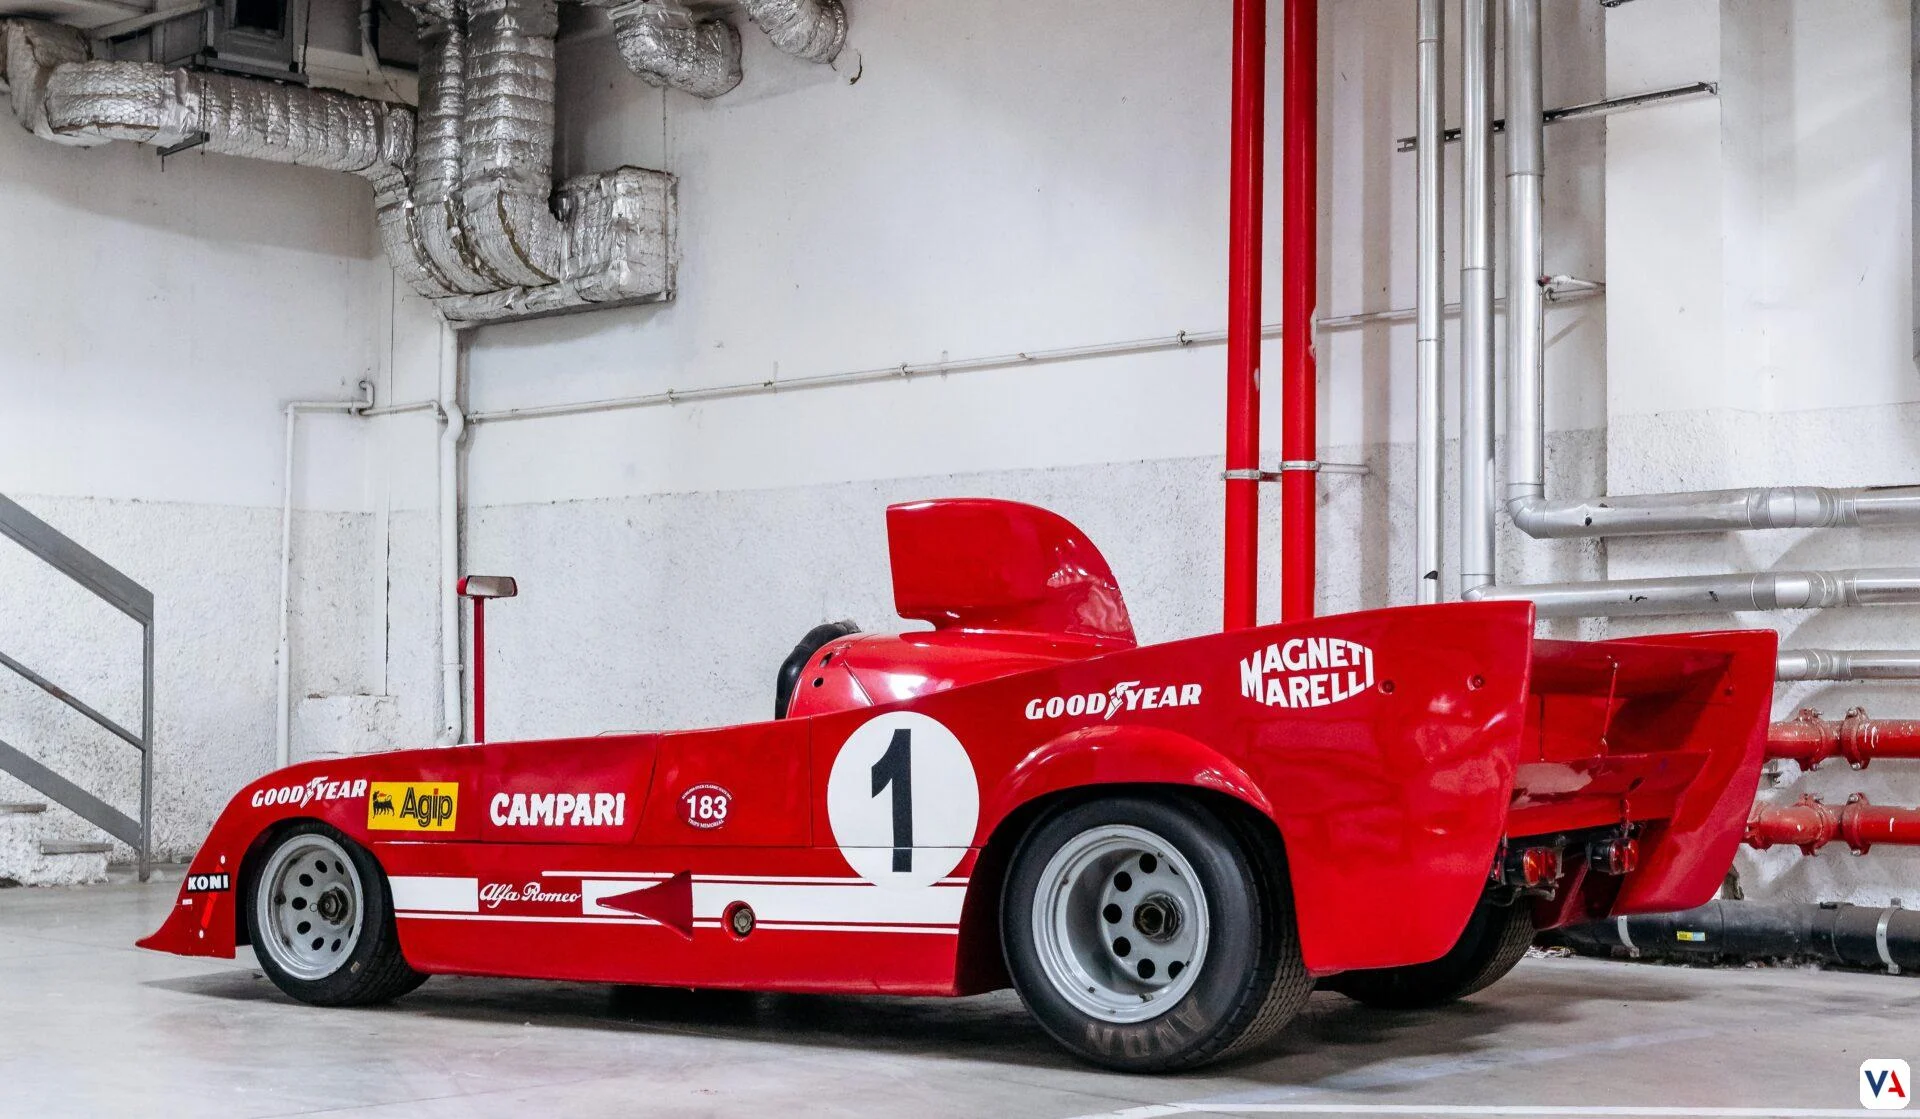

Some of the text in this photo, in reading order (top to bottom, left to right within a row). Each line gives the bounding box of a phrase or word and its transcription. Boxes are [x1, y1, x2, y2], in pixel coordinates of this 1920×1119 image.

[1240, 637, 1374, 676] MAGNETI
[1240, 668, 1374, 708] MARELLI
[400, 787, 453, 827] Agip
[490, 792, 625, 826] CAMPARI
[687, 795, 727, 819] 183
[871, 728, 913, 872] 1
[188, 875, 229, 891] KONI
[479, 881, 581, 909] Alfa Romeo
